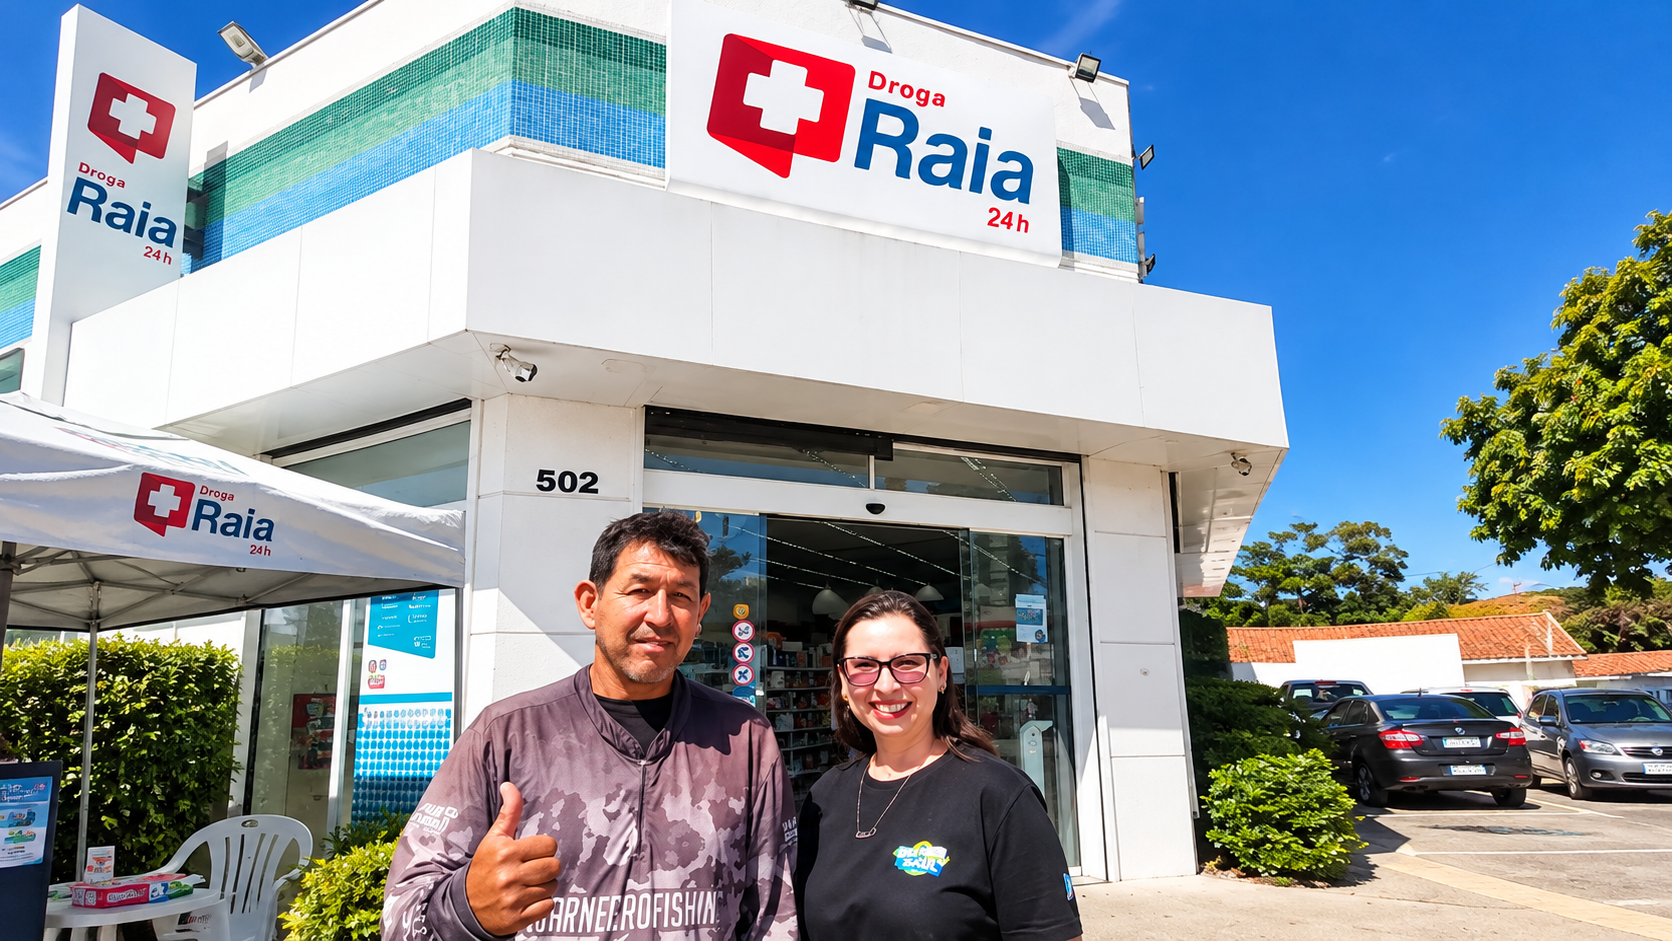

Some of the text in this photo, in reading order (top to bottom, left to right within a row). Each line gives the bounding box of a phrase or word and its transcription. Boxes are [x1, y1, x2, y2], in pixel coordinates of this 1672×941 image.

[867, 70, 946, 107] Droga
[853, 98, 1034, 205] Raia
[78, 161, 126, 189] Droga
[66, 176, 177, 248] Raia
[199, 485, 235, 502] Droga
[536, 469, 599, 495] 502
[191, 498, 275, 542] Raia
